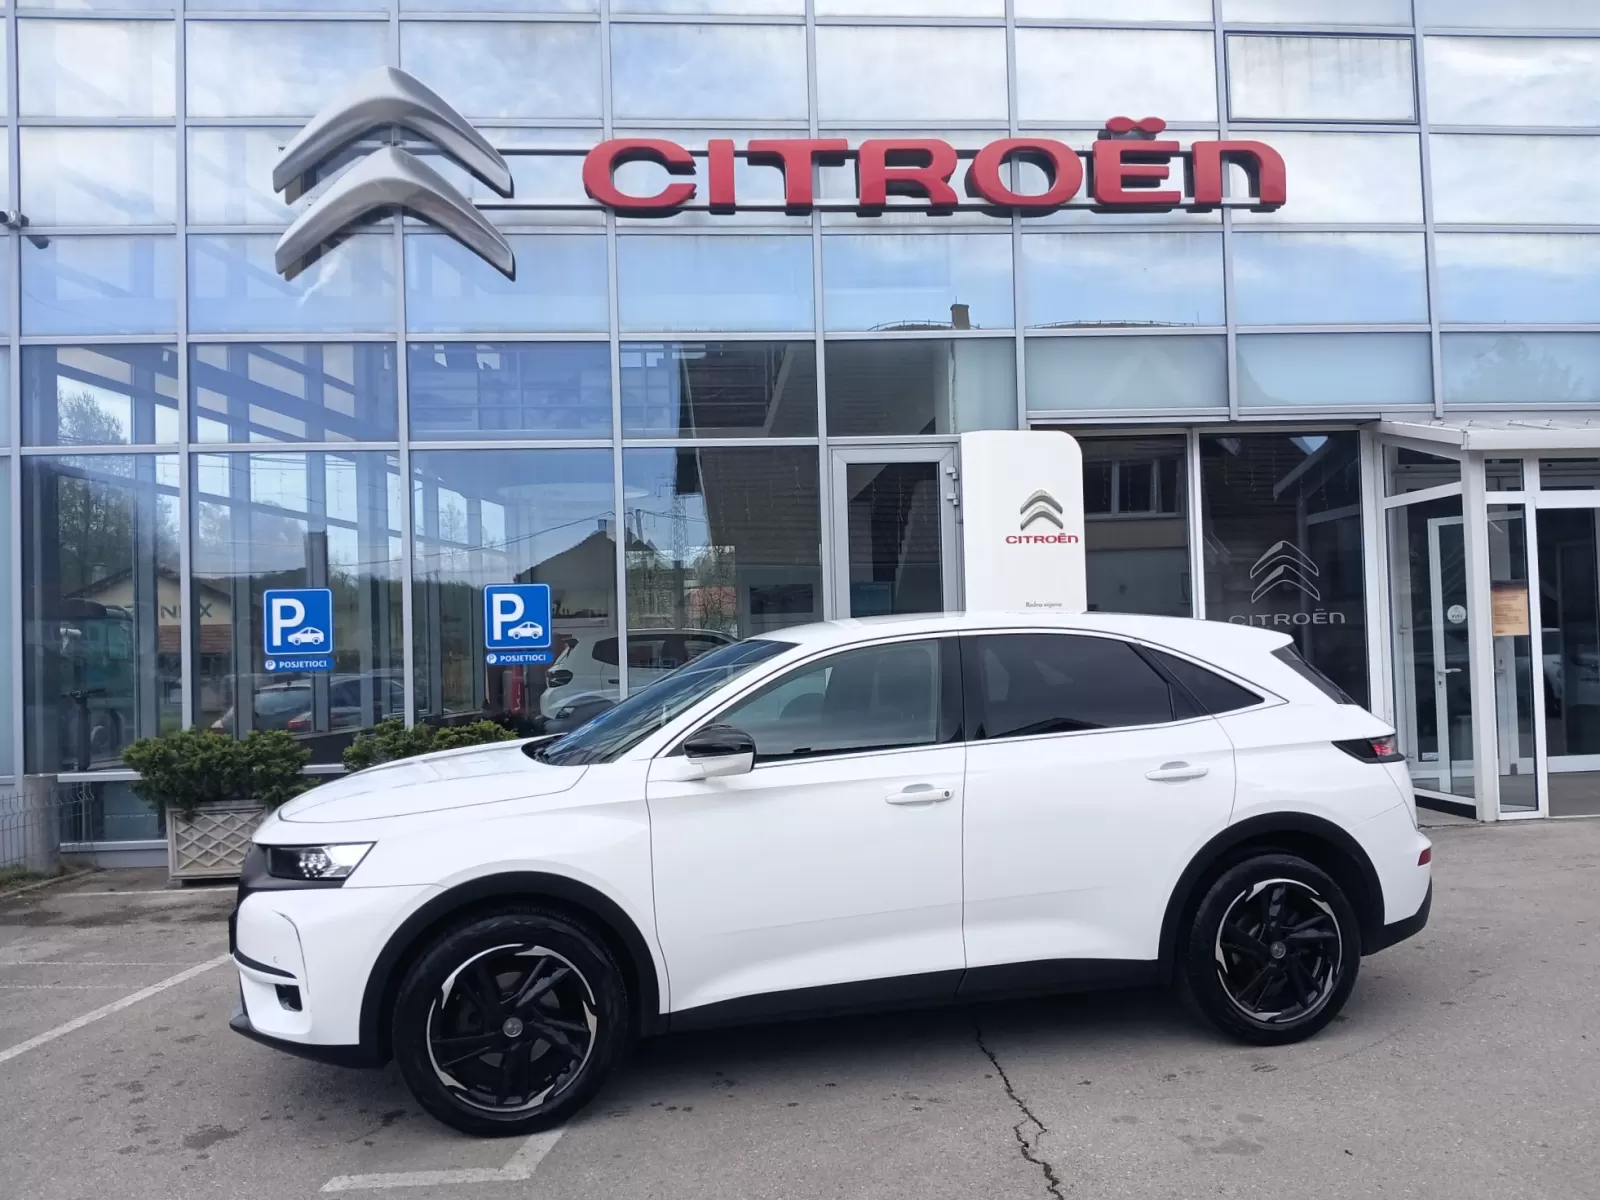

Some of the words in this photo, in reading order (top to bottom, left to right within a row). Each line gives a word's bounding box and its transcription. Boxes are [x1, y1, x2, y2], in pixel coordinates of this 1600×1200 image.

[272, 598, 305, 647] P
[492, 593, 525, 640] P
[279, 660, 327, 668] POSJETIOCI
[500, 654, 546, 662] POSJETIOCI
